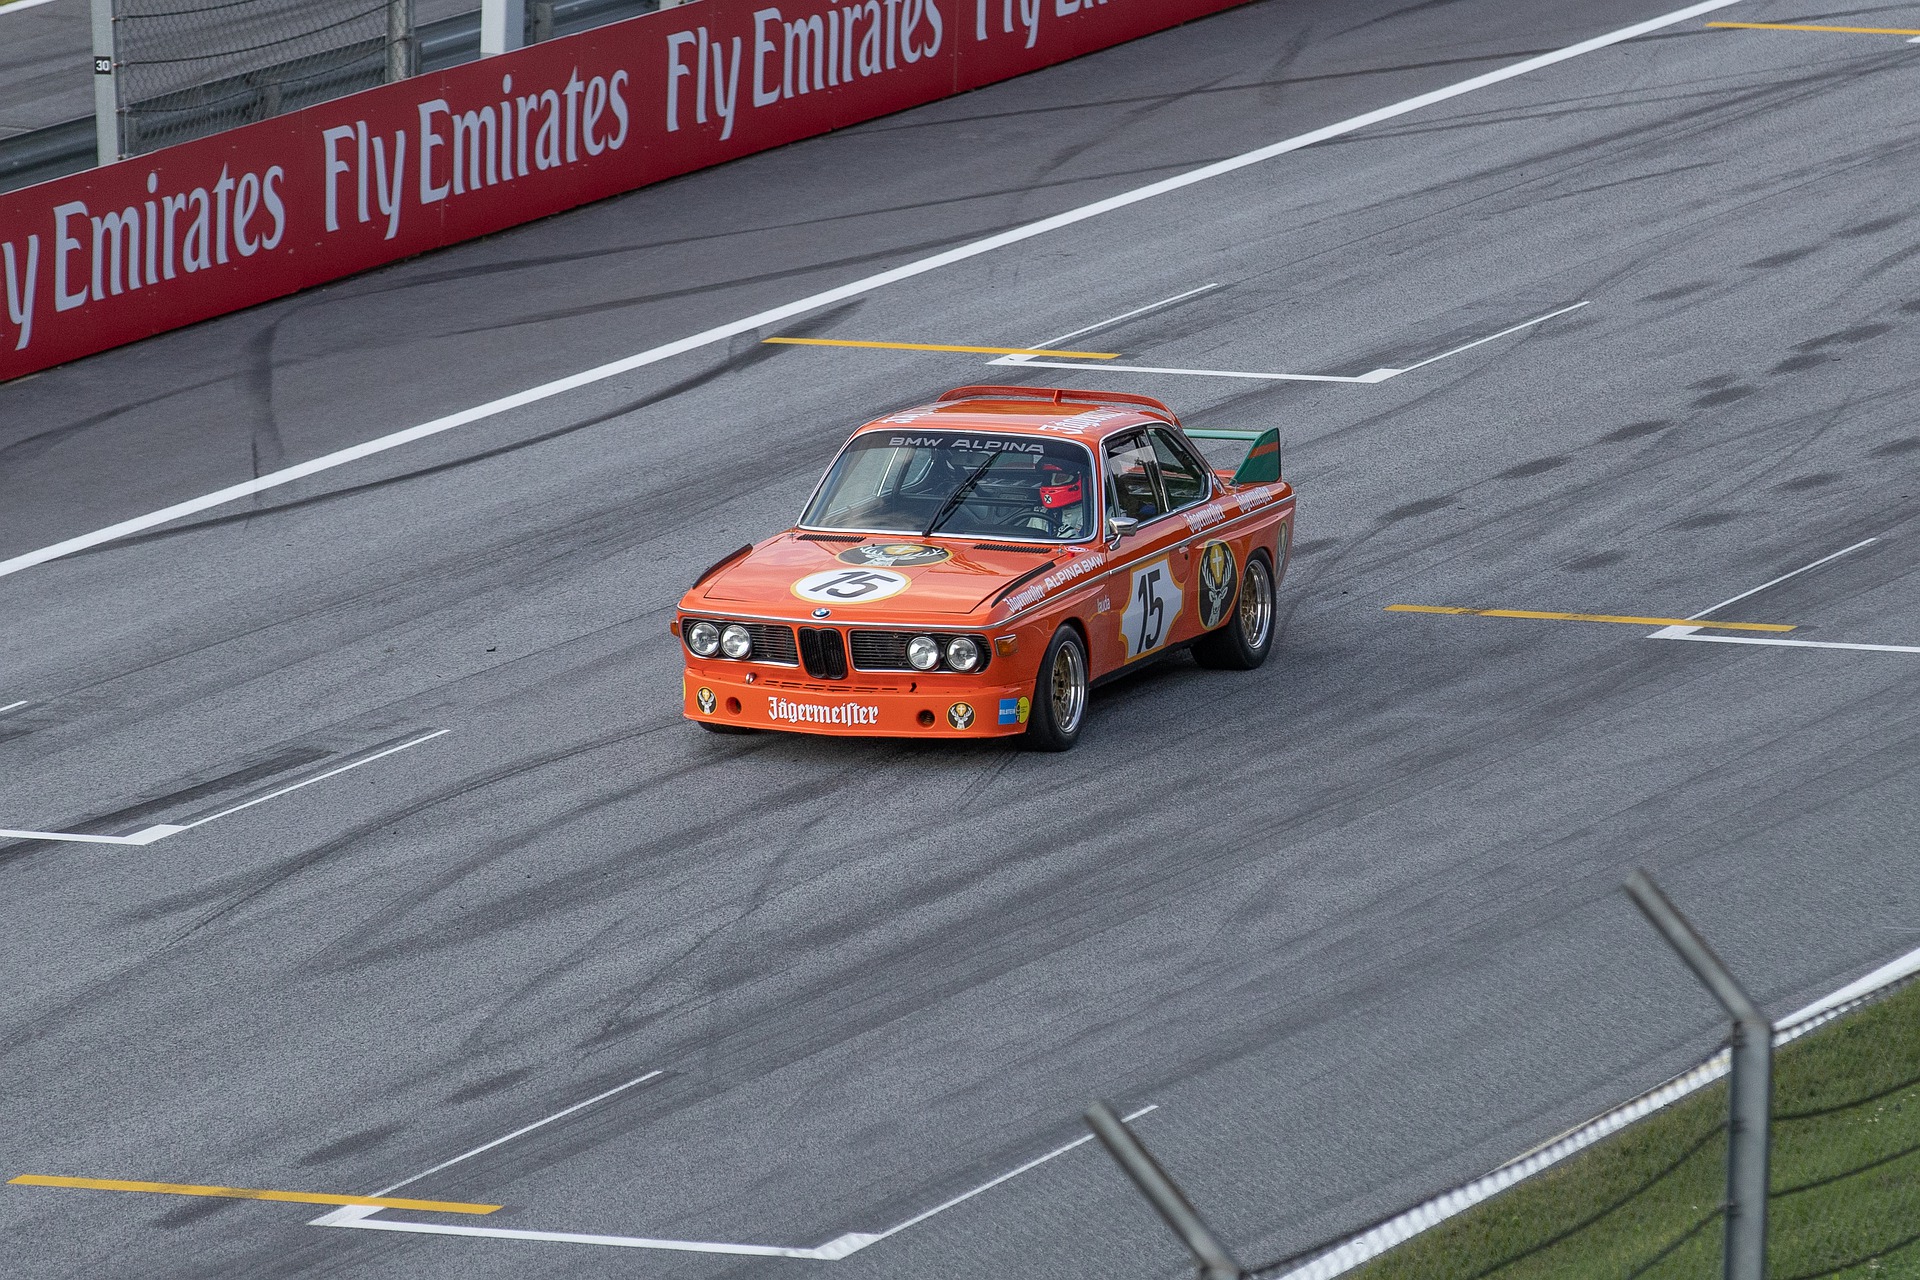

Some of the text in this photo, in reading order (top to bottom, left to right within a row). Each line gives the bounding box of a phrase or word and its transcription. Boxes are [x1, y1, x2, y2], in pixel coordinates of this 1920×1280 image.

[95, 60, 110, 71] 30
[667, 27, 742, 141] Fly
[753, 0, 943, 107] Emirates
[323, 66, 629, 240] Fly Emirates
[53, 162, 286, 312] Emirates
[889, 437, 1044, 454] BMW ALPINA
[808, 571, 899, 598] 15
[1044, 563, 1084, 590] ALPINA
[1081, 553, 1104, 573] BMW
[1136, 569, 1164, 655] 15
